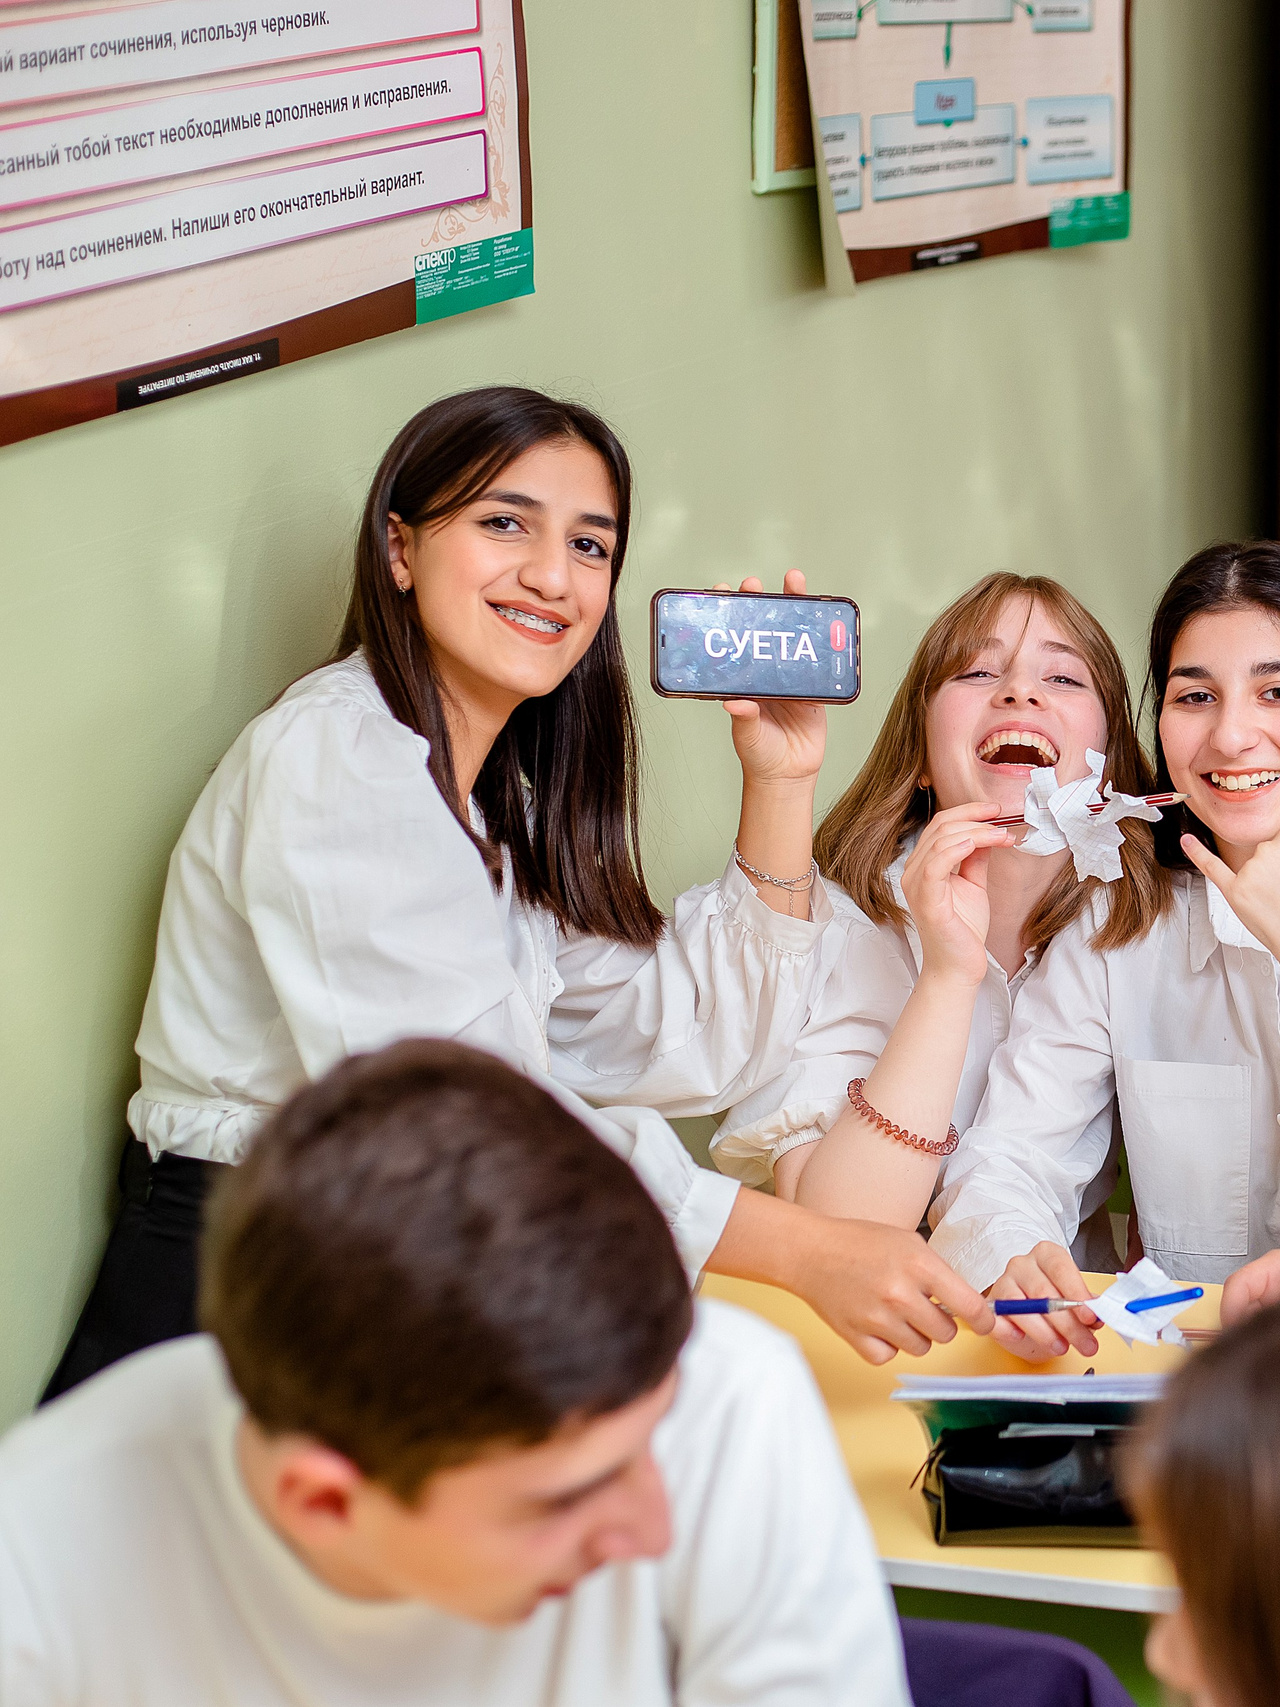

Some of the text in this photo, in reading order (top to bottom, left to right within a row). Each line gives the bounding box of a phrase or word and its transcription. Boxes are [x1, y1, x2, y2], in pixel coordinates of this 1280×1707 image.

[19, 45, 85, 72] вариант
[90, 32, 177, 58] сочинения,
[181, 20, 257, 42] используя
[261, 10, 330, 36] черновик.
[64, 134, 111, 162] тобой
[114, 130, 155, 153] текст
[160, 111, 262, 144] необходимые
[265, 97, 348, 129] дополнения
[352, 94, 360, 110] и
[364, 80, 452, 108] исправления.
[36, 249, 66, 271] над
[69, 227, 167, 262] сочинением.
[172, 212, 230, 239] Напиши
[233, 206, 256, 225] его
[260, 177, 367, 219] окончательный
[371, 170, 425, 197] вариант.
[184, 364, 220, 382] СОЧИНЕНИЕ
[219, 358, 242, 371] ПИСАТЬ
[137, 376, 175, 395] ЛИТЕРАТУРЕ
[175, 374, 185, 386] ПО
[704, 628, 818, 662] СУЕТА
